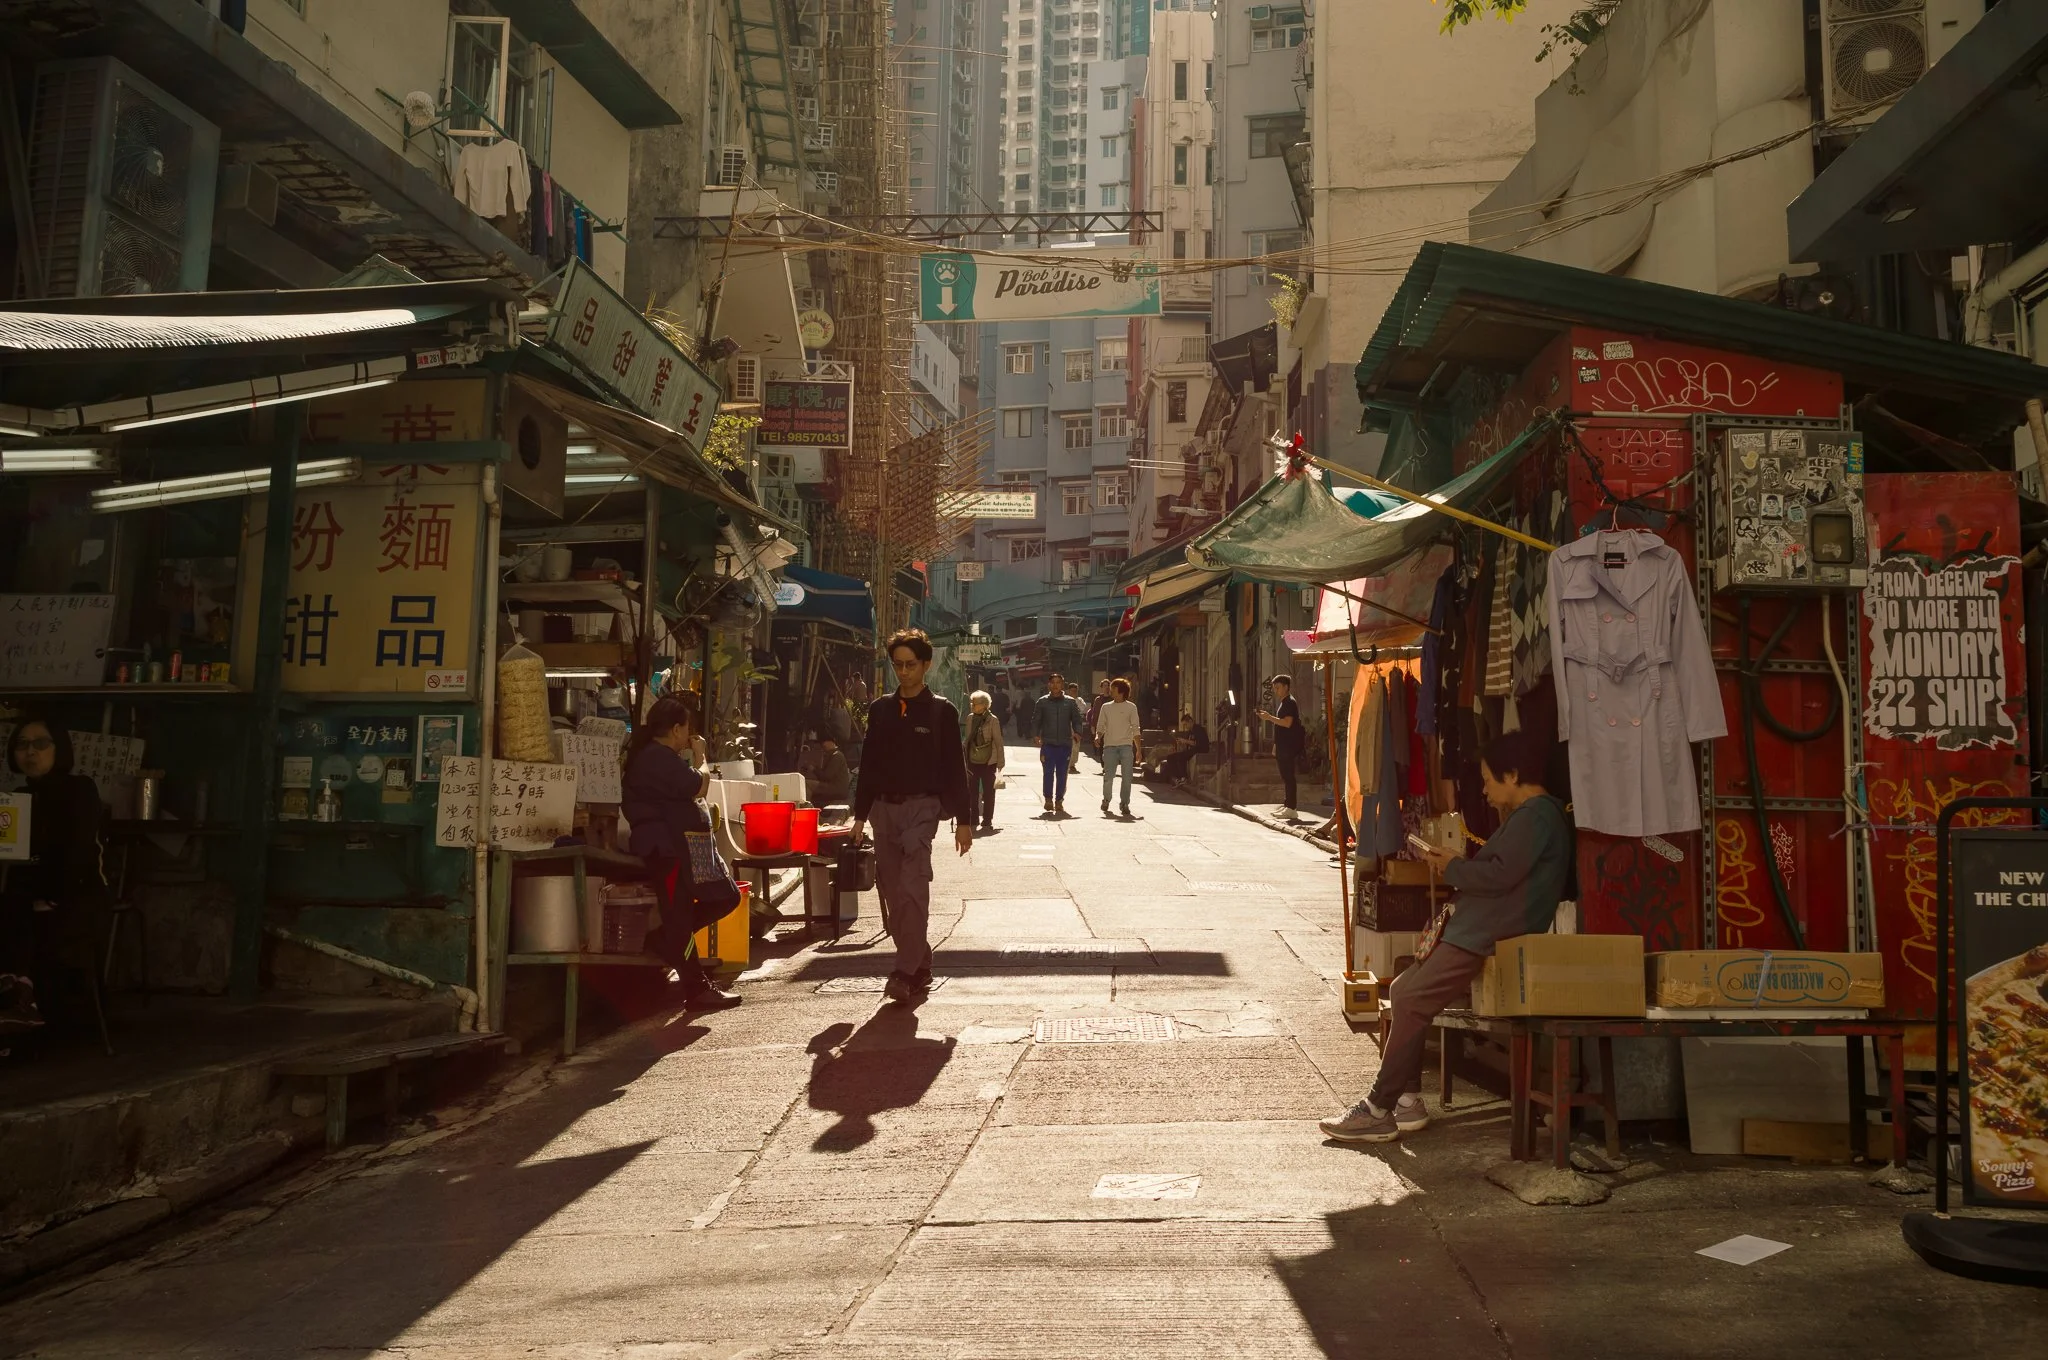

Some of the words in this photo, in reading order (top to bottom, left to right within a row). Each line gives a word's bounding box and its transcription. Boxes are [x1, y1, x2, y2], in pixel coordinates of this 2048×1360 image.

[994, 269, 1101, 298] Paradise
[1022, 269, 1060, 282] Bob's
[794, 407, 847, 421] Massage
[793, 419, 847, 433] Massage
[787, 432, 846, 443] 98570431
[1607, 428, 1684, 448] JAPE
[1611, 451, 1672, 468] NDC
[292, 498, 456, 574] 粉麵
[1873, 571, 1920, 597] FROM
[1906, 599, 1960, 629] MORE
[281, 594, 446, 668] 甜品
[1878, 679, 1916, 727] 22
[347, 725, 409, 746] 全力支持
[1999, 871, 2046, 886] NEW
[1973, 891, 2013, 906] THE
[2016, 891, 2048, 907] CH
[1743, 972, 1779, 990] BAERY
[1978, 1158, 2034, 1176] Sonny's
[1991, 1173, 2036, 1189] Pizza
